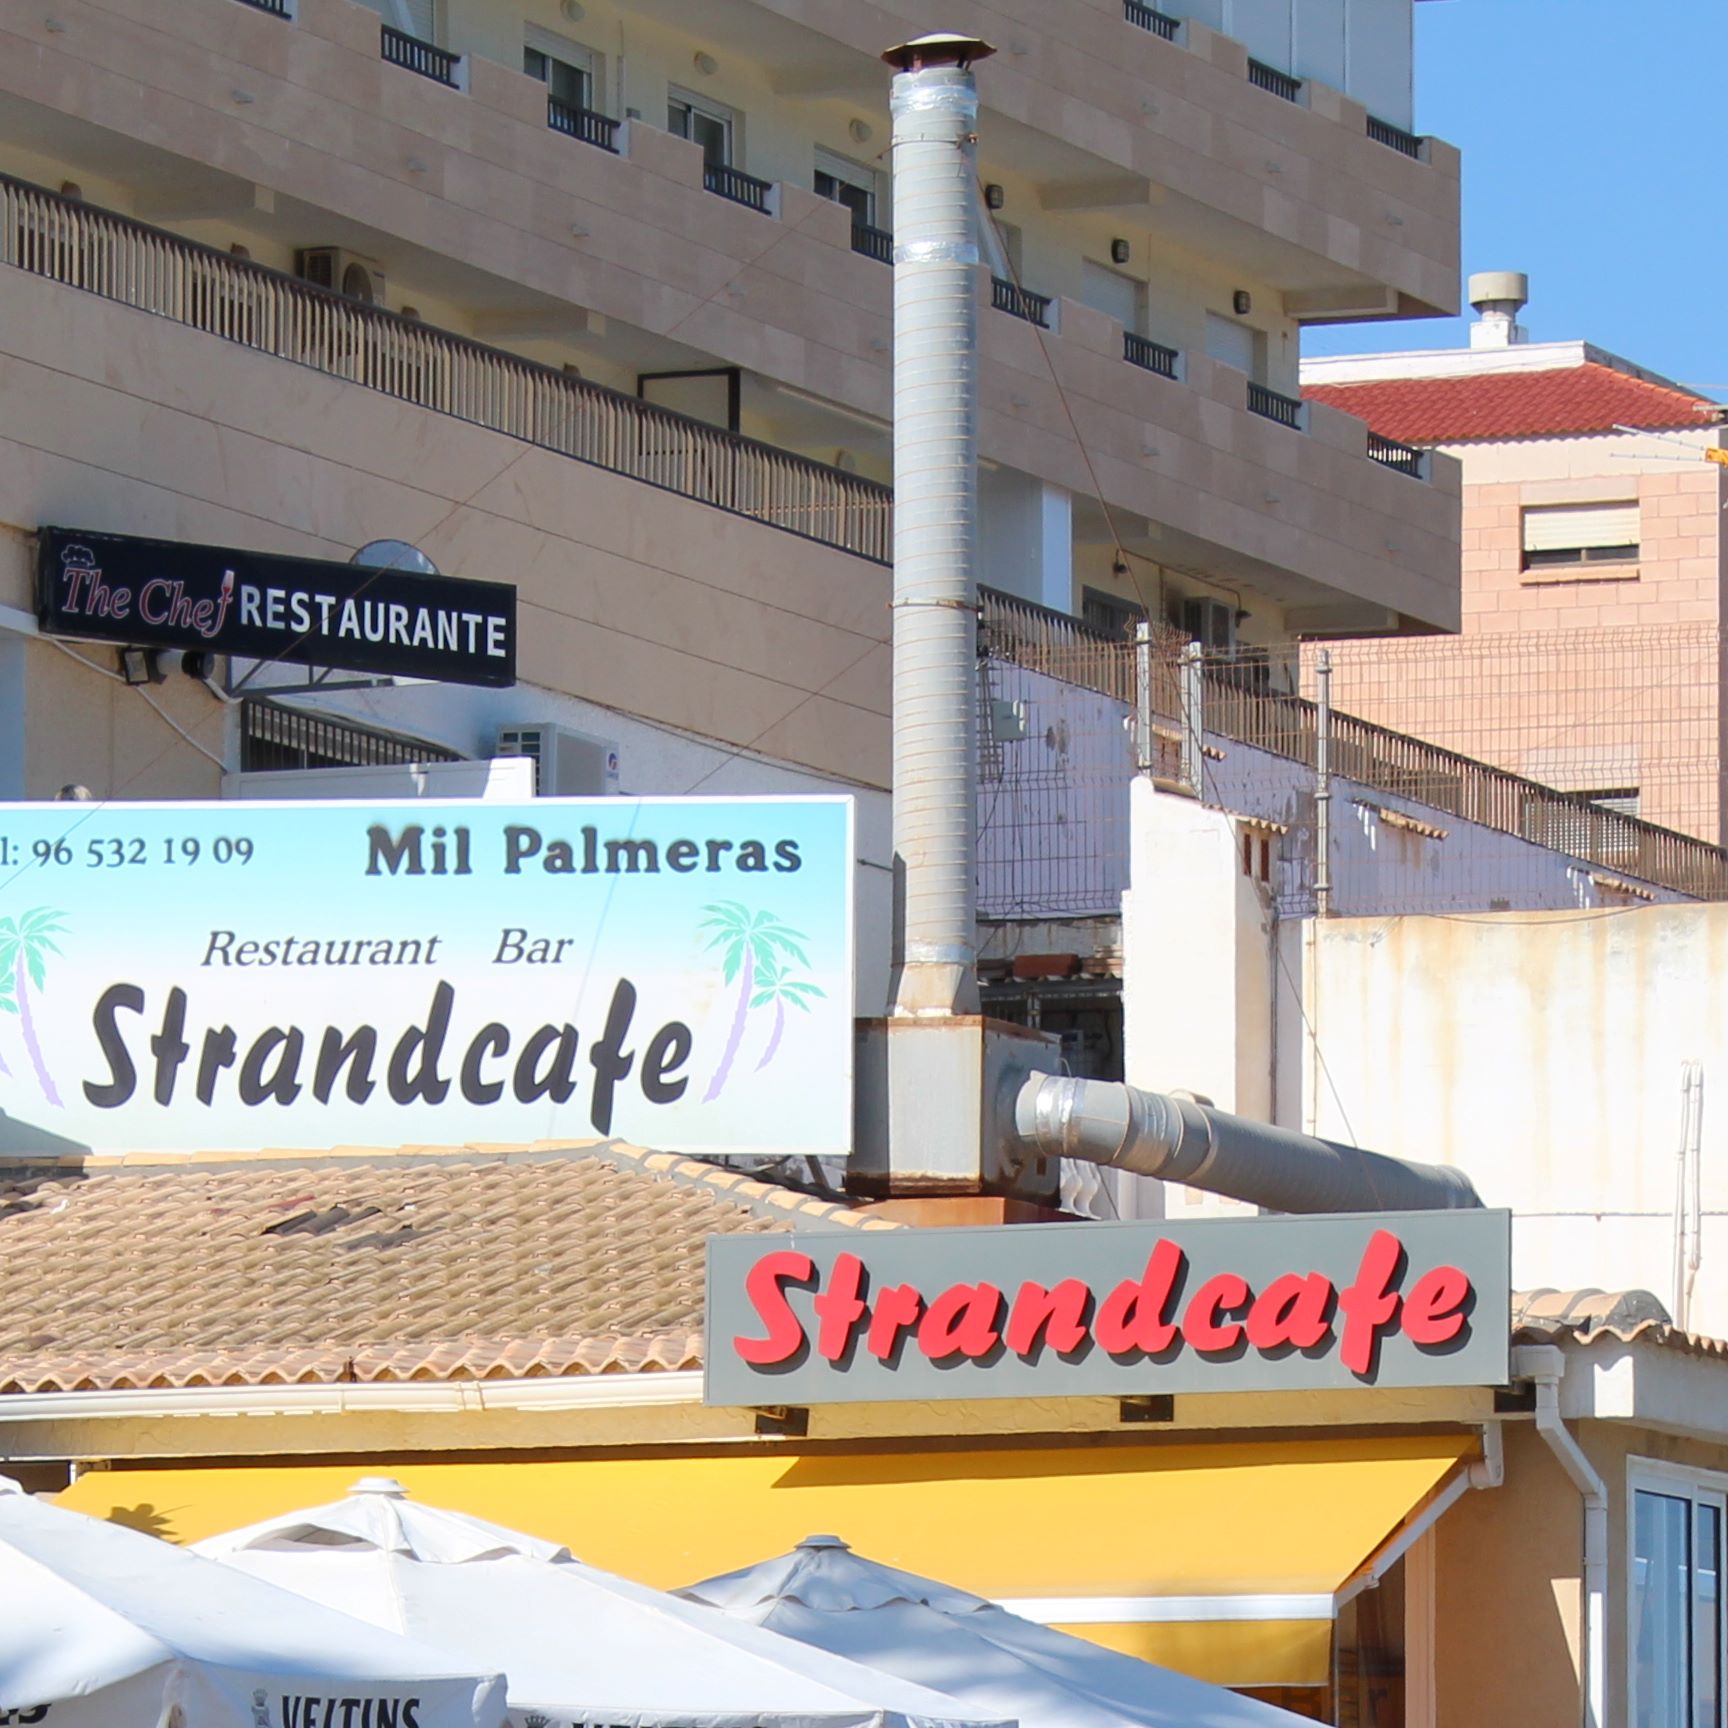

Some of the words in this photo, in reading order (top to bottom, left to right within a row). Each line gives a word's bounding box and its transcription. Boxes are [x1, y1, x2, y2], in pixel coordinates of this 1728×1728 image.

[61, 567, 131, 619] The
[138, 569, 235, 638] Chef
[240, 583, 507, 657] RESTAURANTE
[32, 837, 73, 868] 96
[85, 837, 147, 868] 532
[161, 837, 202, 868] 19
[212, 836, 254, 867] 09
[364, 824, 472, 877] Mil
[503, 824, 803, 875] Palmeras
[201, 930, 442, 967] Restaurant
[492, 928, 574, 966] Bar
[83, 977, 692, 1136] Strandcafe
[733, 1228, 1472, 1375] Strandcafe
